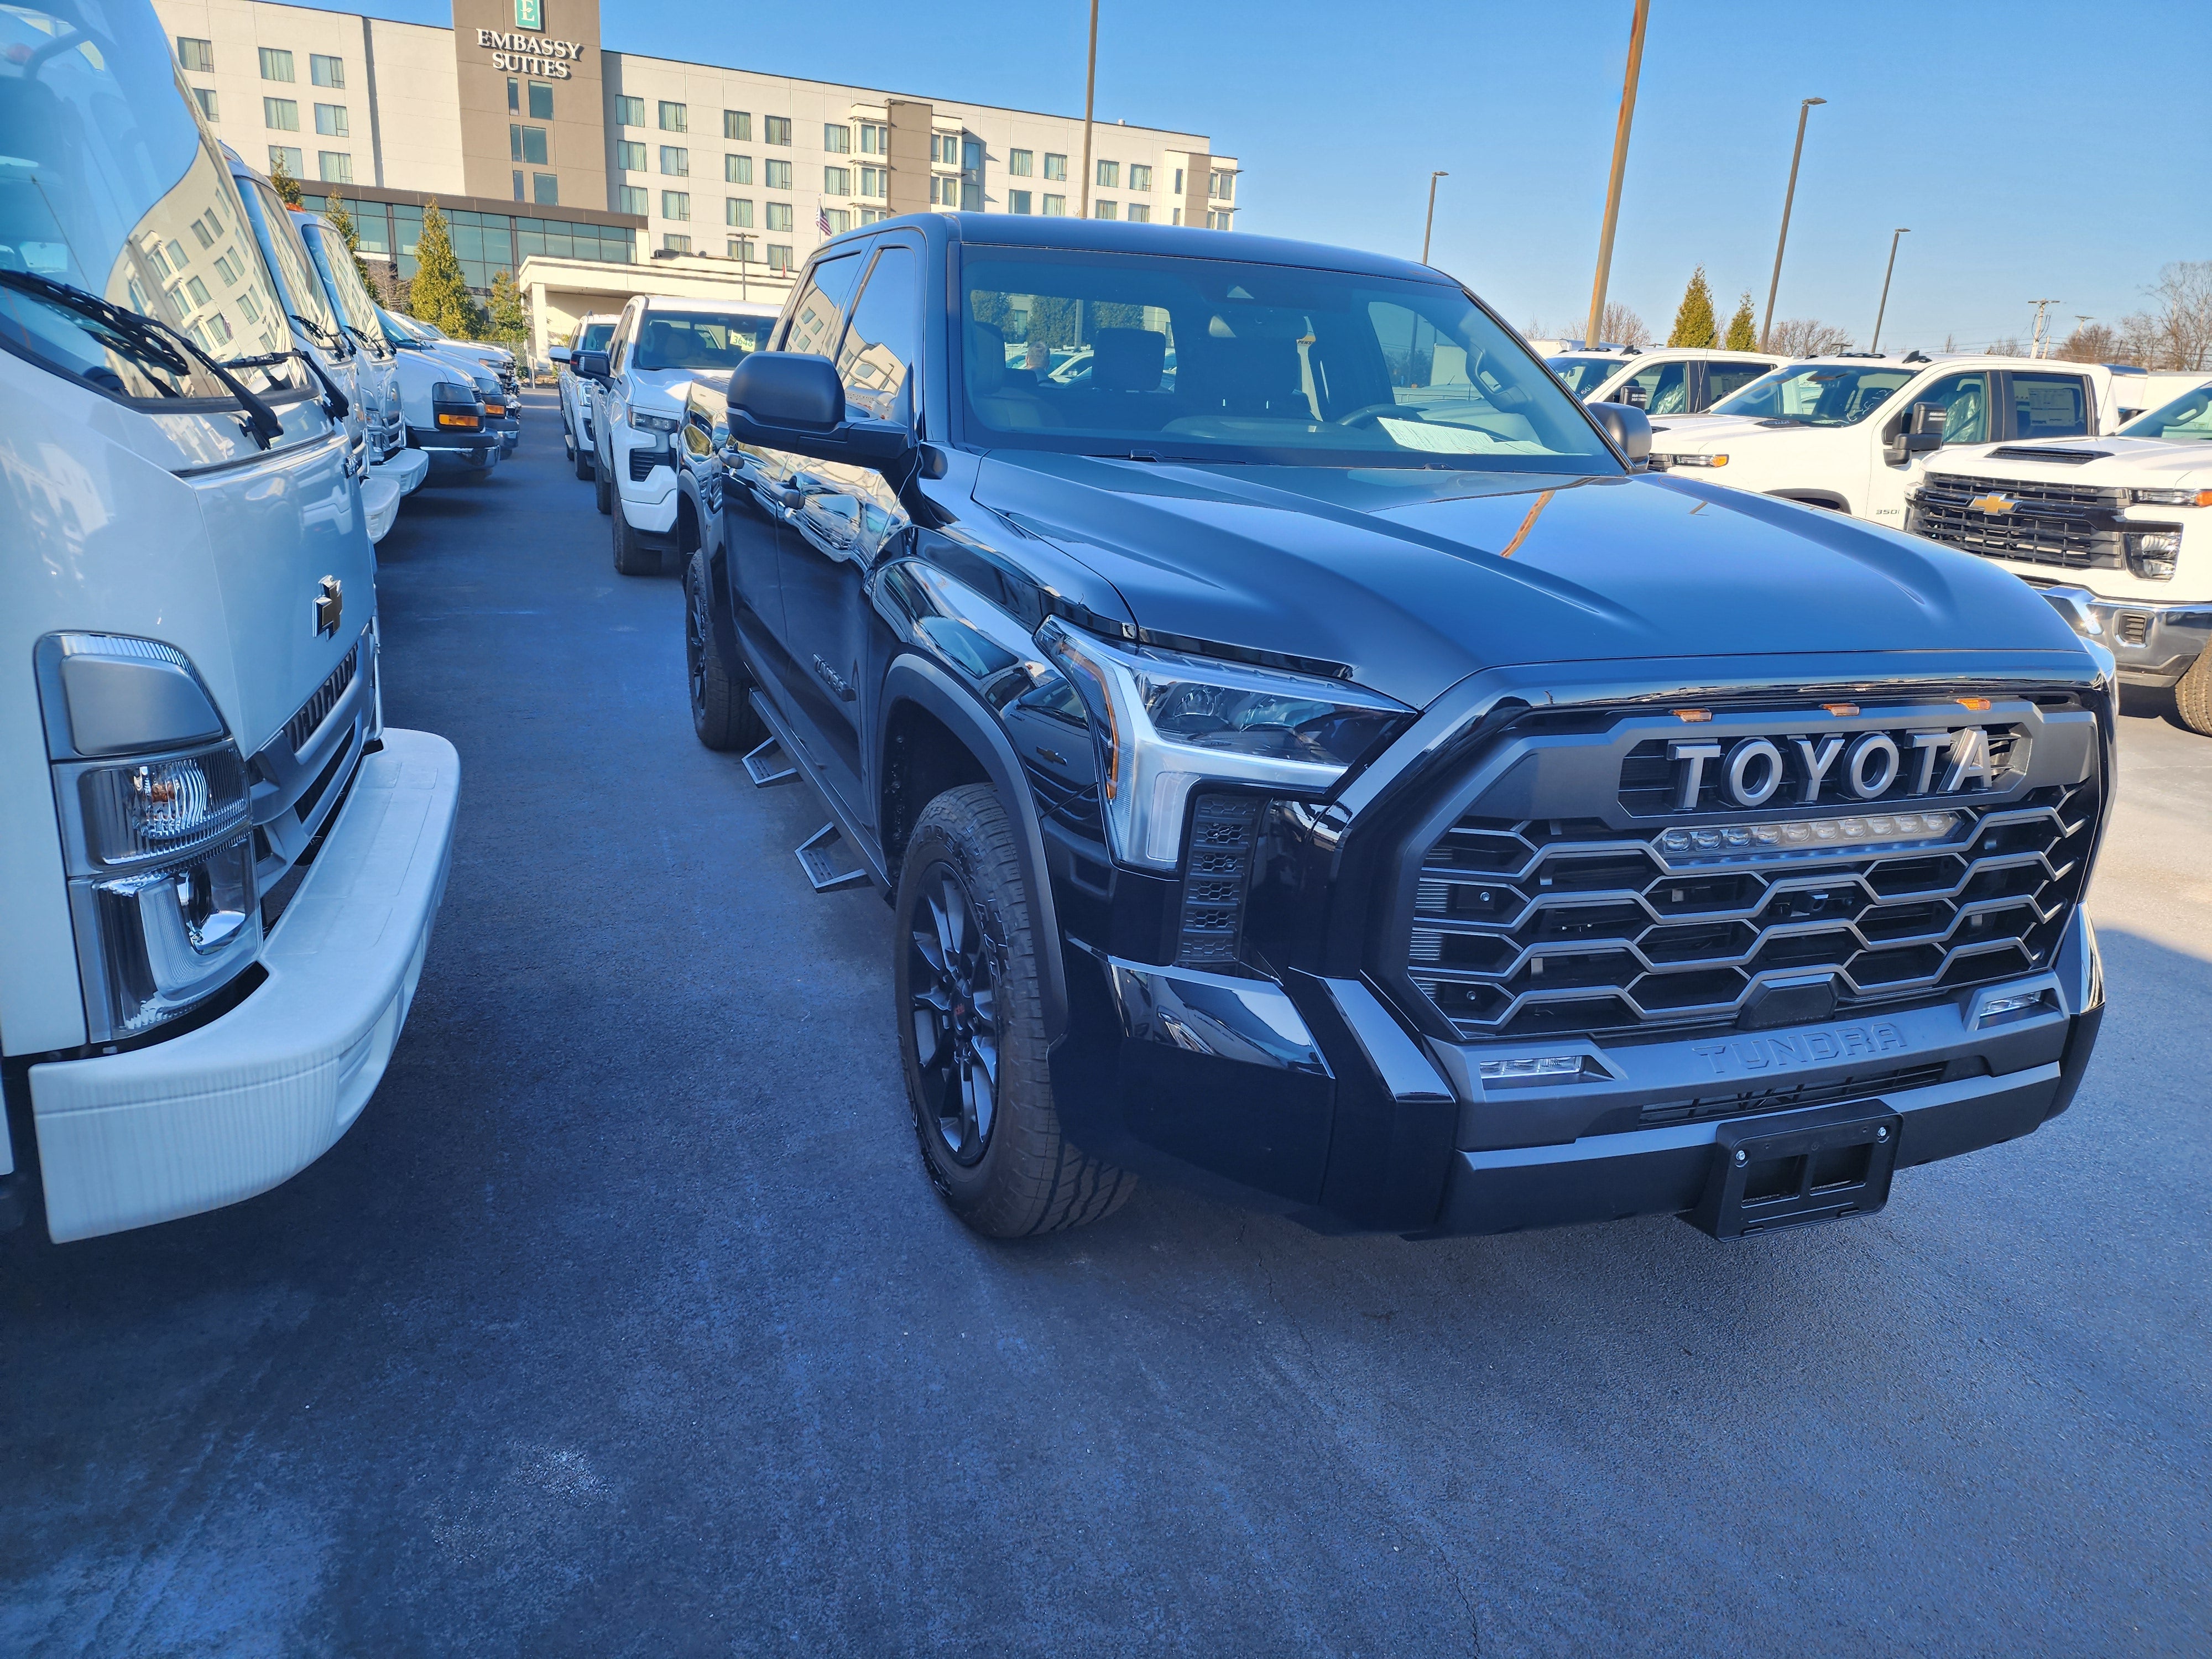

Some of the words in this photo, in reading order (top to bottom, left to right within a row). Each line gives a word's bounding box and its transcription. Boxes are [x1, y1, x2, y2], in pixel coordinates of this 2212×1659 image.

[476, 28, 580, 59] EMBASSY
[492, 52, 567, 78] SUITES
[733, 335, 753, 347] 3648
[1667, 726, 1993, 810] TOYOTA
[1692, 1022, 1907, 1074] TUNDRA
